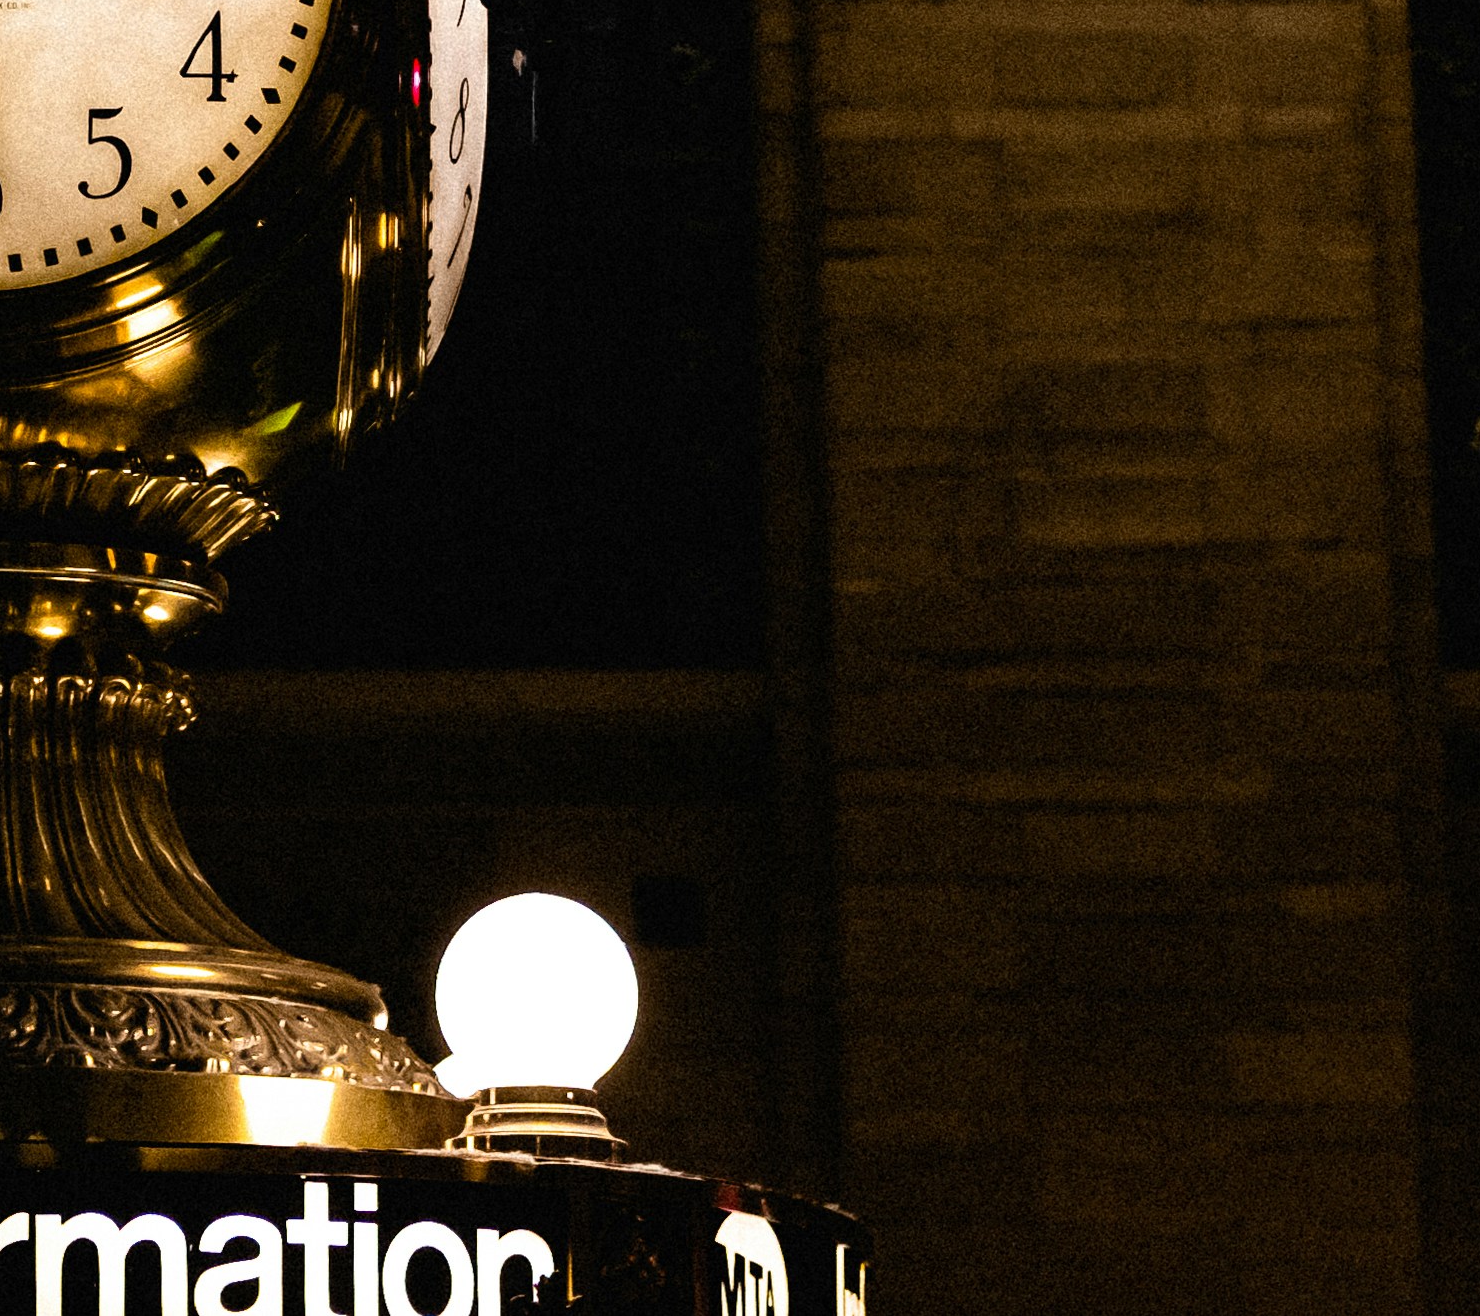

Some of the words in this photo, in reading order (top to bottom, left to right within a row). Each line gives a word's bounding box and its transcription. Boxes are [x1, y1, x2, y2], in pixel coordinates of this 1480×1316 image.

[178, 9, 239, 103] 4
[77, 105, 133, 201] 5
[448, 76, 470, 166] 8
[714, 1242, 776, 1316] MTA
